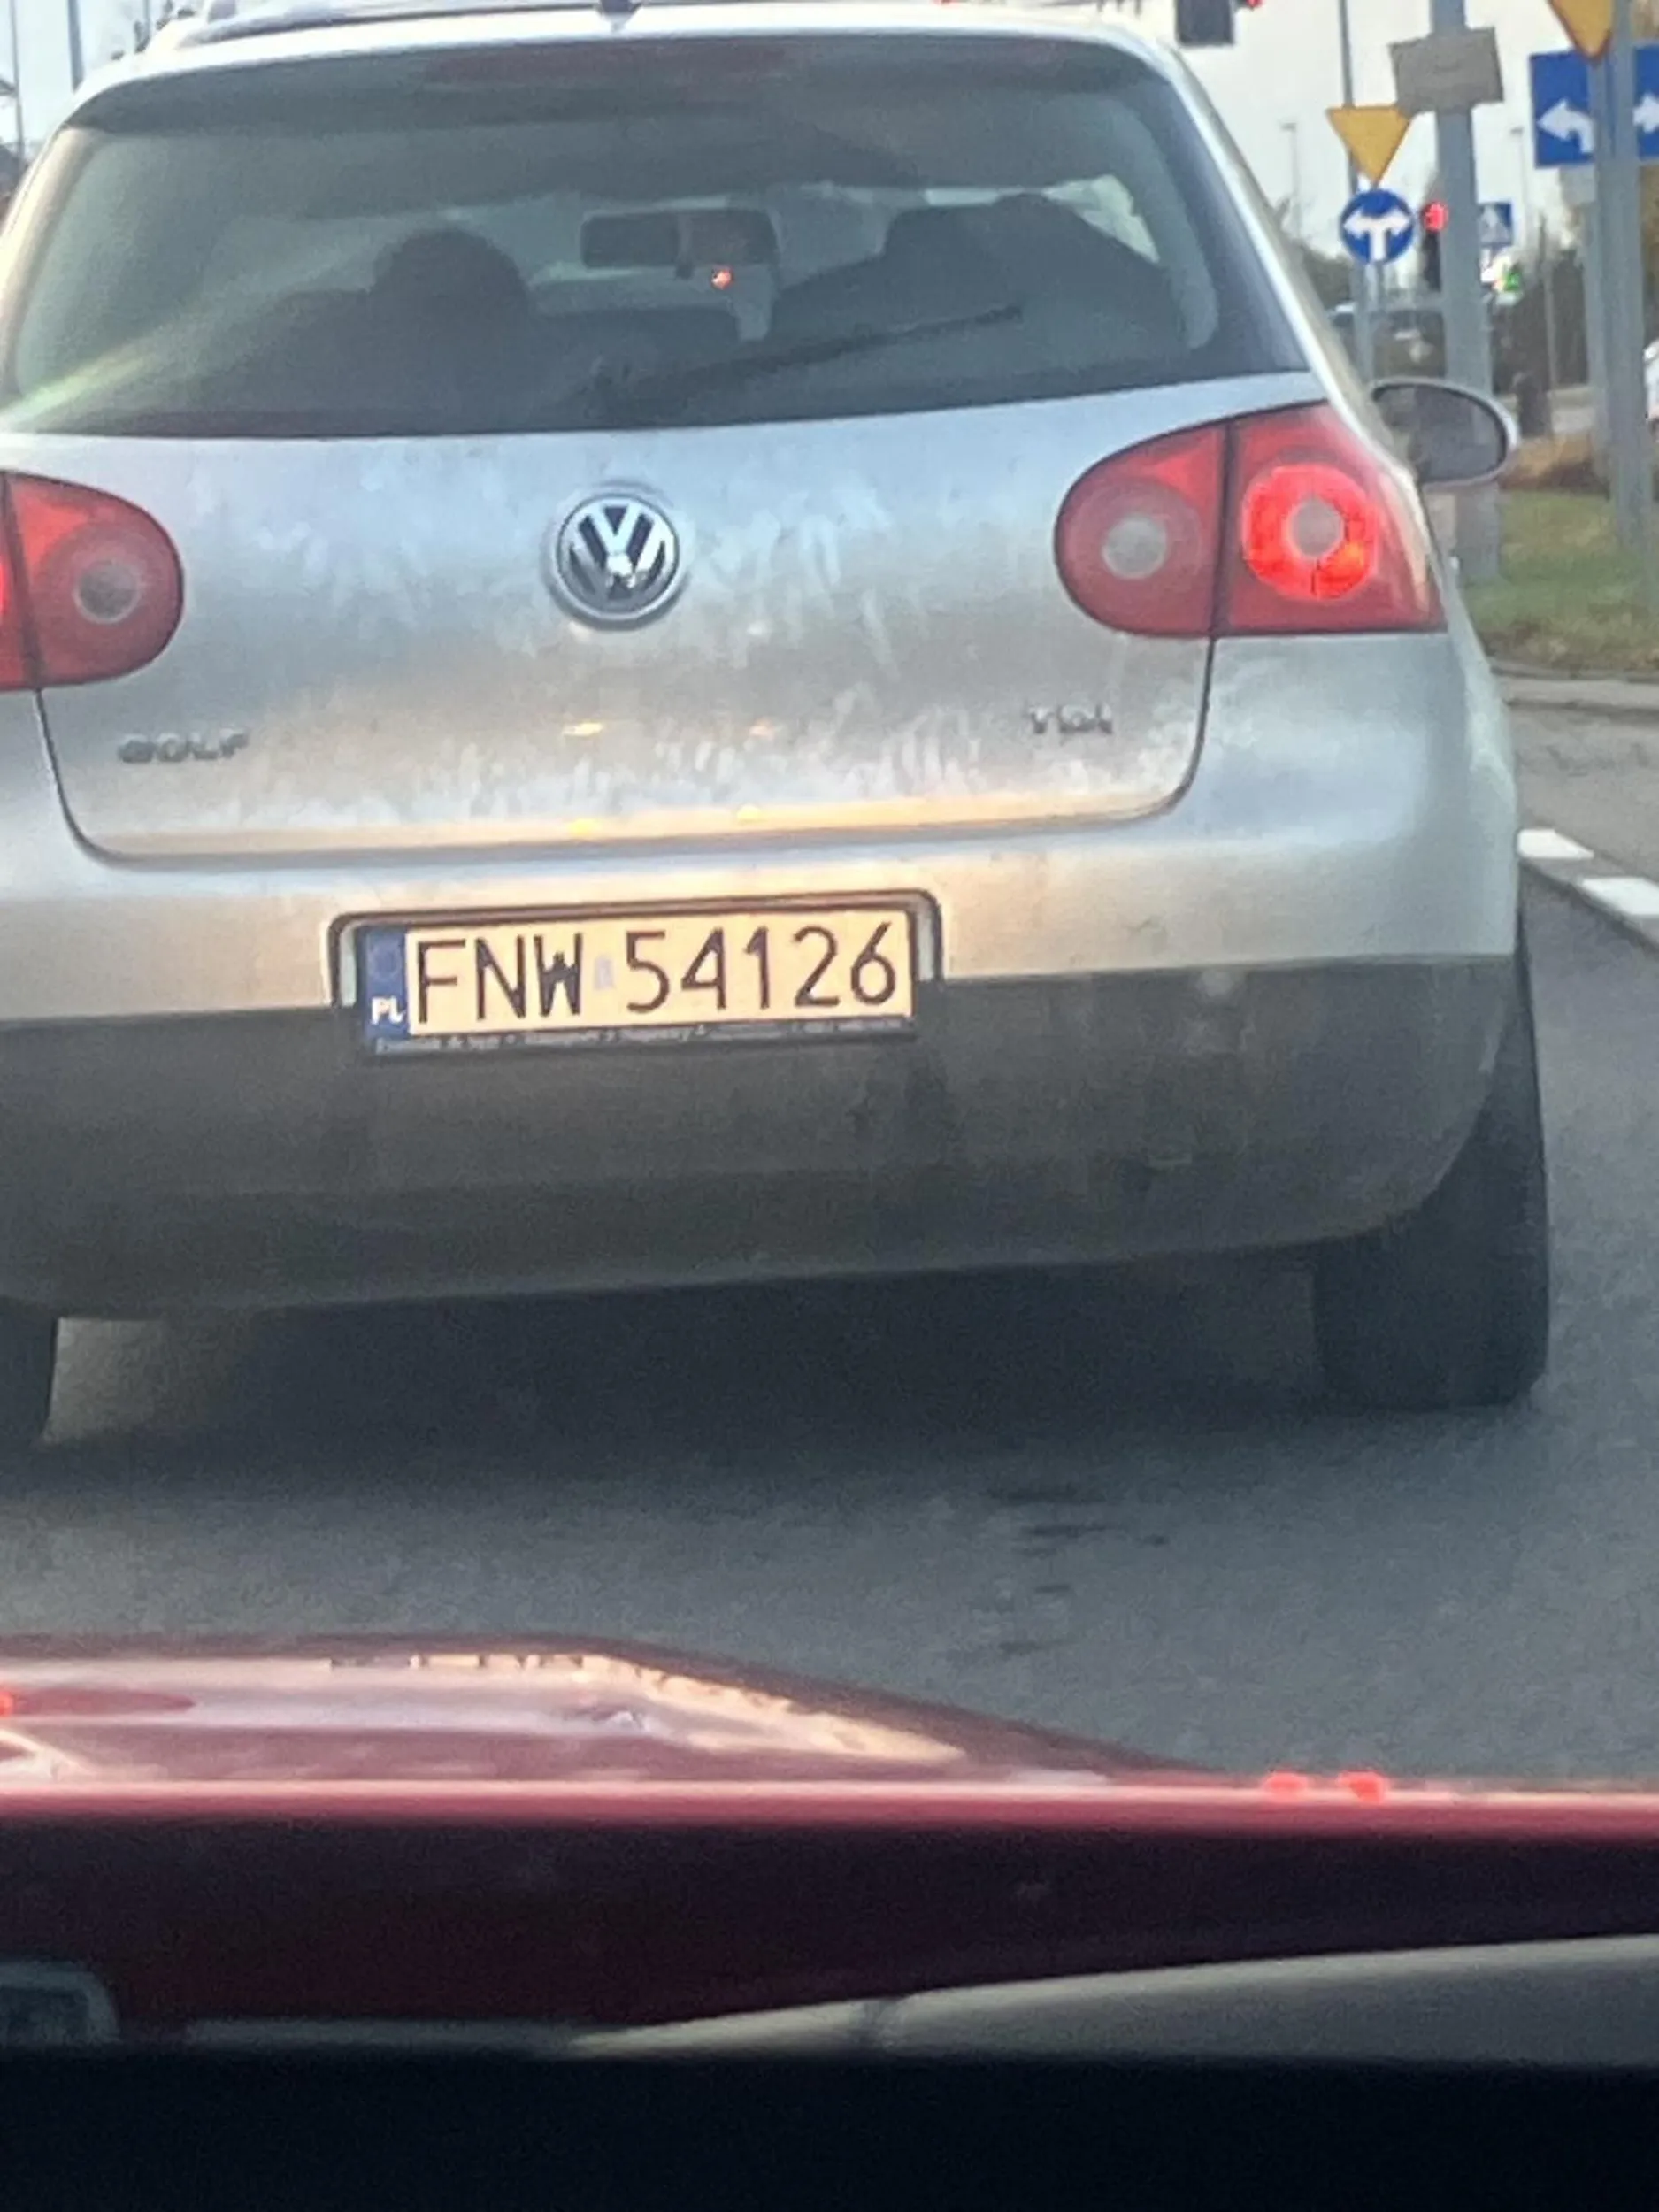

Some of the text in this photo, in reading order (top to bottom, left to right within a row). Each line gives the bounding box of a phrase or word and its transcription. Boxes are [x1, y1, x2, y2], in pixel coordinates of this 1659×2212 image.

[416, 923, 897, 1024] FNW 54126
[371, 996, 404, 1025] PL
